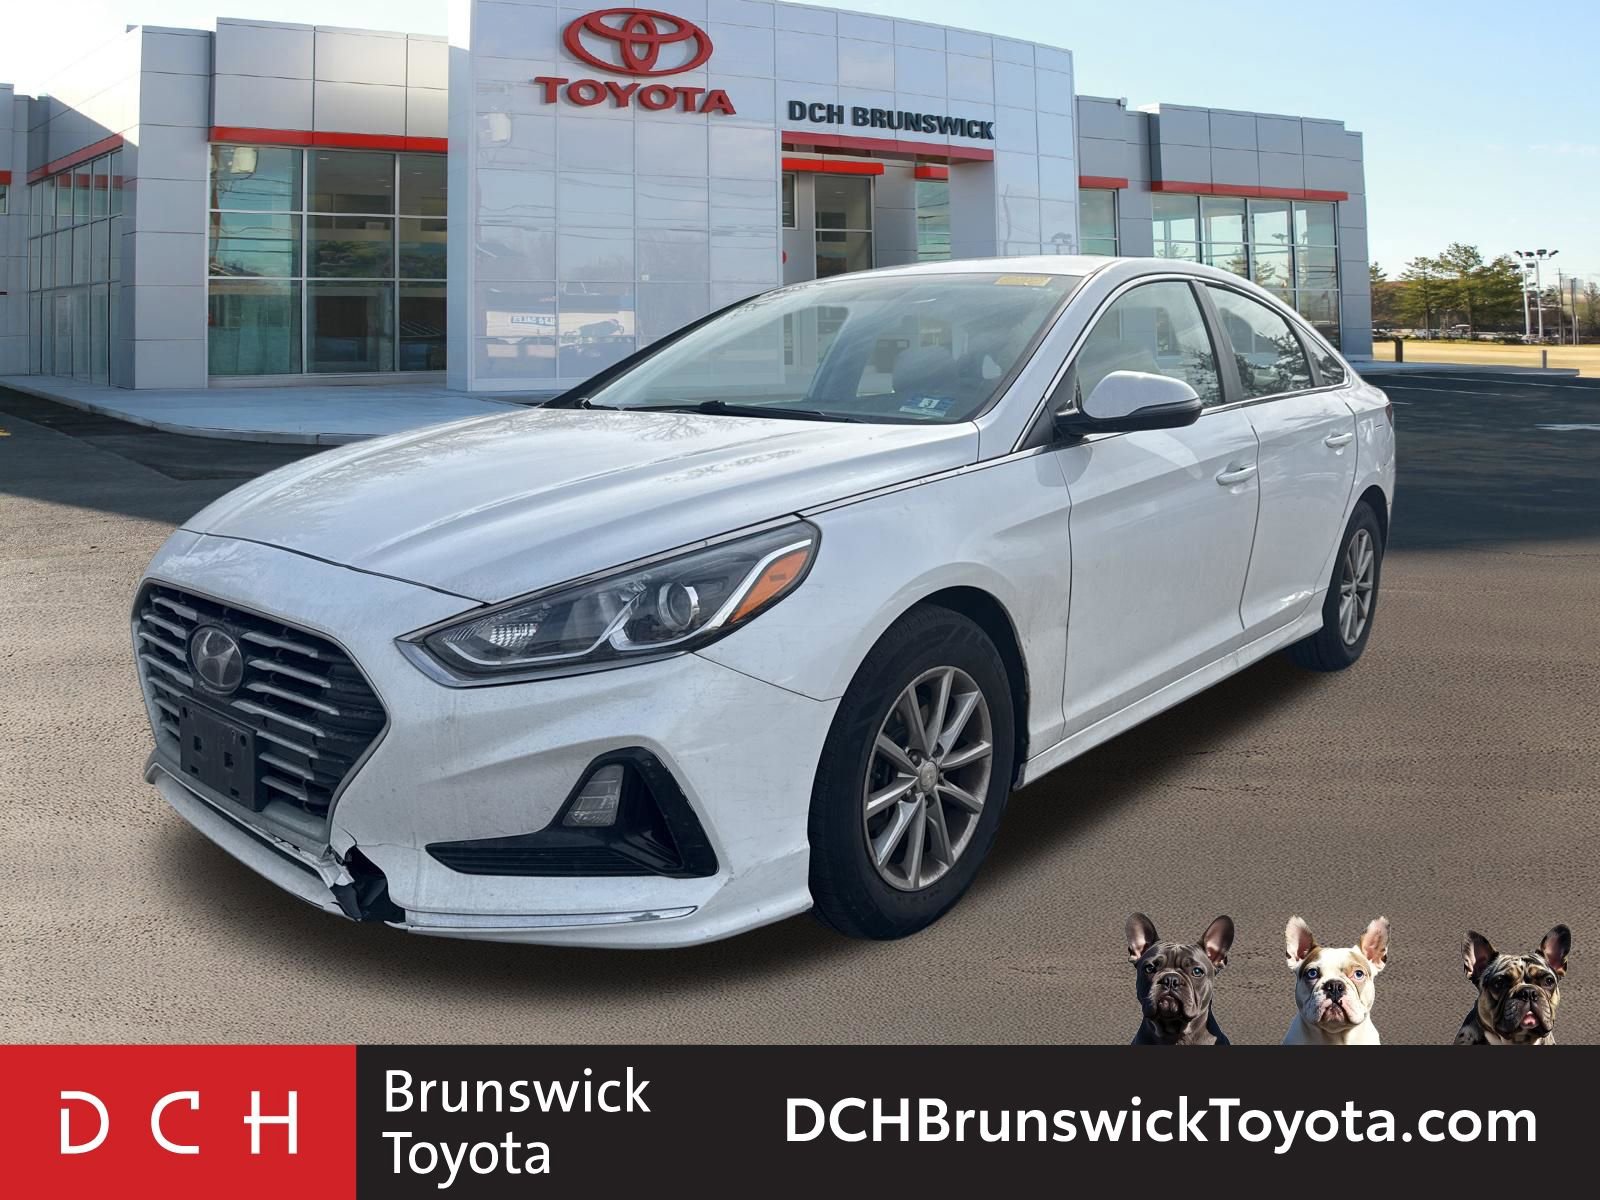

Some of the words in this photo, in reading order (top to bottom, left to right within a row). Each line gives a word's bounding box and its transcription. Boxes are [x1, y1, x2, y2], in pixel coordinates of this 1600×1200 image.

[534, 77, 736, 115] TOYOTA
[789, 101, 844, 125] DCH
[852, 107, 994, 140] BRUNSWICK
